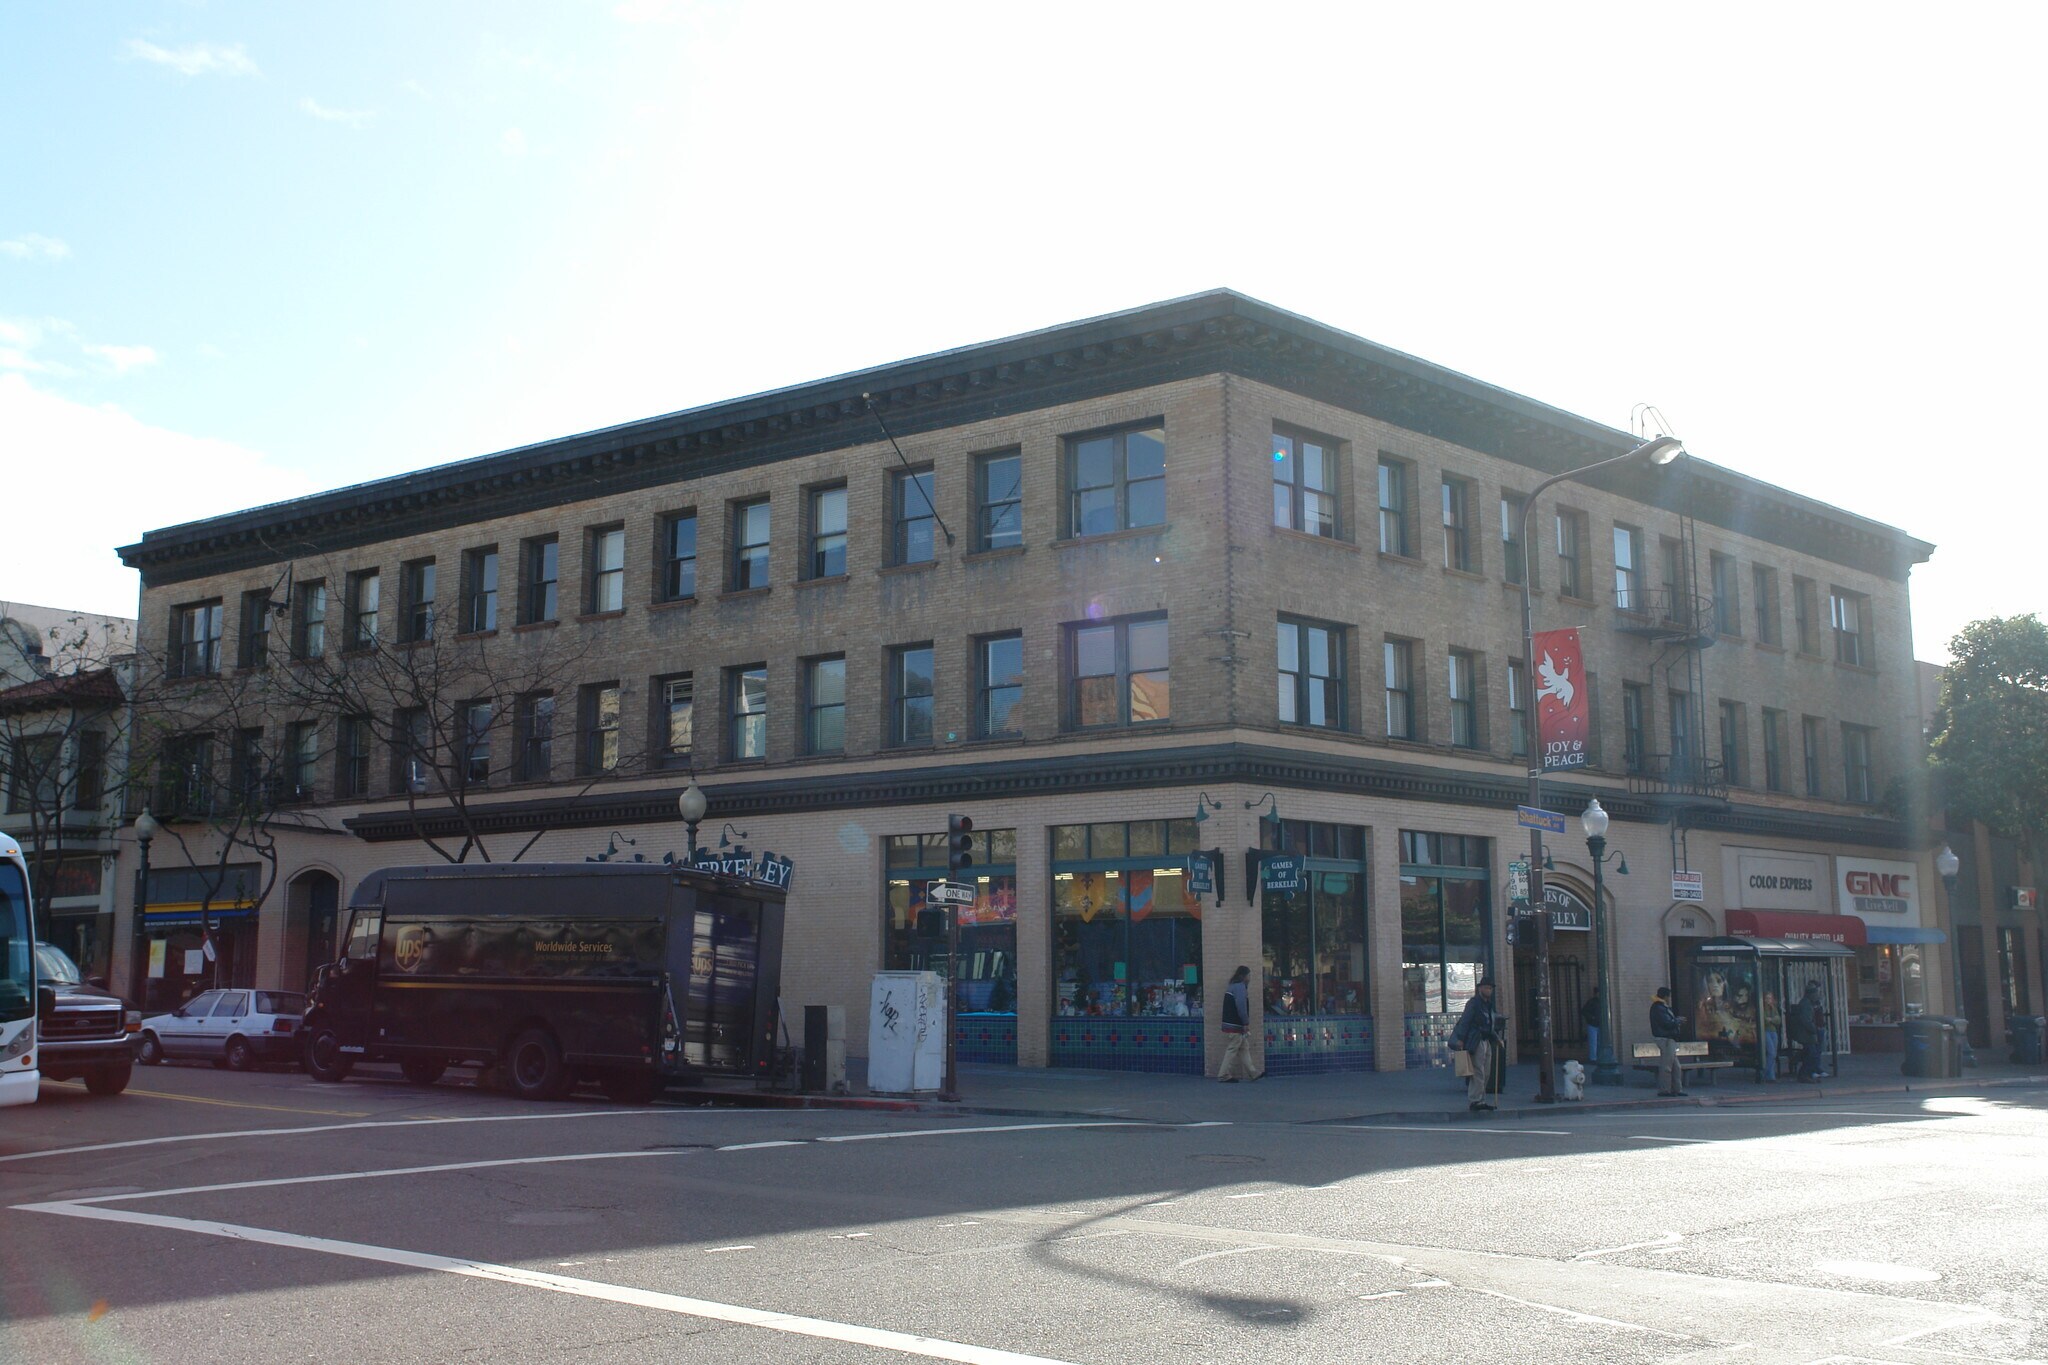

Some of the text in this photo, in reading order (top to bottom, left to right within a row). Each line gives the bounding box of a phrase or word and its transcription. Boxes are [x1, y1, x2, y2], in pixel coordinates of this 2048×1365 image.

[1546, 739, 1582, 755] JOY &
[1544, 752, 1584, 768] PEACE
[1519, 810, 1551, 828] Shattuck
[1271, 861, 1293, 870] GAMES
[1278, 871, 1286, 879] OF
[1266, 880, 1298, 889] BERKELEY
[1749, 875, 1812, 891] COLOR EXPRESS
[1845, 870, 1910, 898] GNC
[946, 889, 972, 900] ONE WAY
[1558, 893, 1571, 907] OF
[1833, 934, 1844, 943] LAB
[397, 940, 421, 964] ups
[535, 940, 613, 953] Worldwide Services
[695, 957, 712, 976] ups
